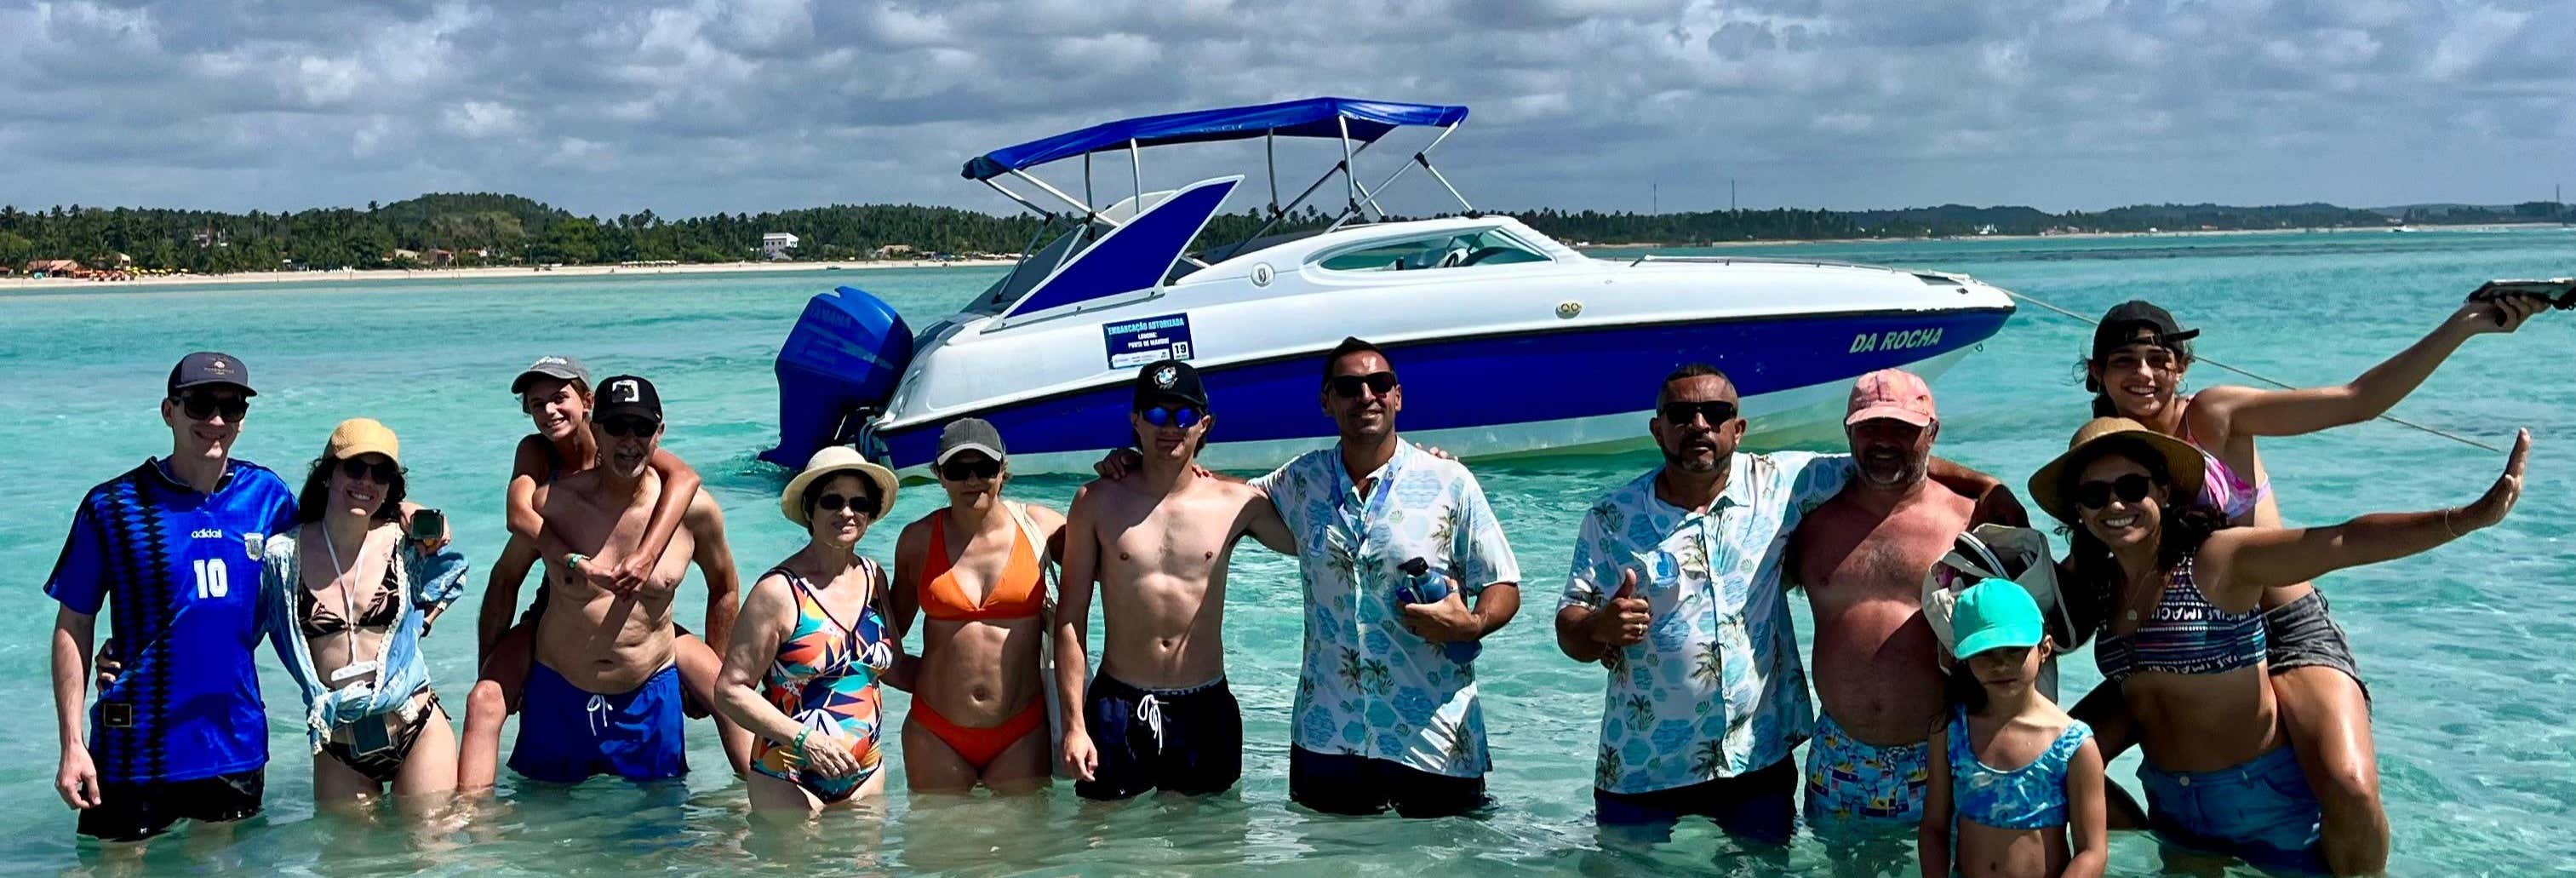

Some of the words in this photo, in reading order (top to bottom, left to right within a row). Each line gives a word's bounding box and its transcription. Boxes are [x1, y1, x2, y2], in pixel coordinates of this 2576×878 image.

[1148, 318, 1185, 330] AUTORIZADA
[1849, 333, 1878, 353] DA
[1880, 327, 1943, 351] ROCHA
[1174, 343, 1187, 354] 19
[192, 529, 222, 538] adidas
[193, 558, 228, 599] 10
